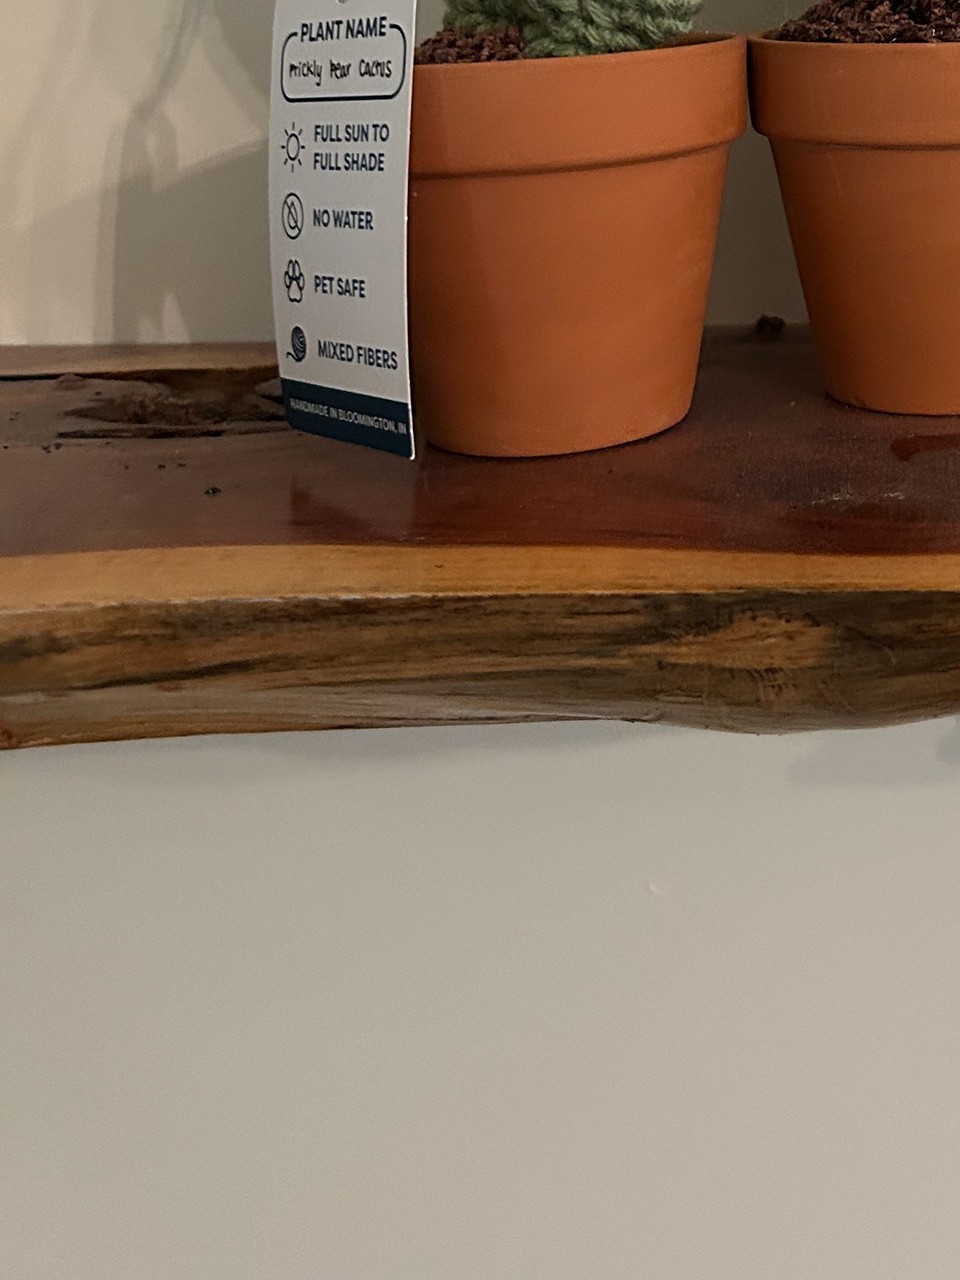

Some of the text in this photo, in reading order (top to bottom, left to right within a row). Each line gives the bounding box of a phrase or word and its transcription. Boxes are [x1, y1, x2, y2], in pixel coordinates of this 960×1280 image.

[301, 16, 388, 42] PLANT NAME
[314, 123, 390, 142] FULL SUN TO
[313, 152, 385, 171] FULL SHADE
[313, 208, 374, 231] NO WATER
[314, 275, 366, 299] PET SAFE
[317, 339, 398, 370] MIXED FIBERS
[289, 398, 329, 417] HANDMADE
[329, 407, 338, 419] IN
[397, 421, 407, 435] IN
